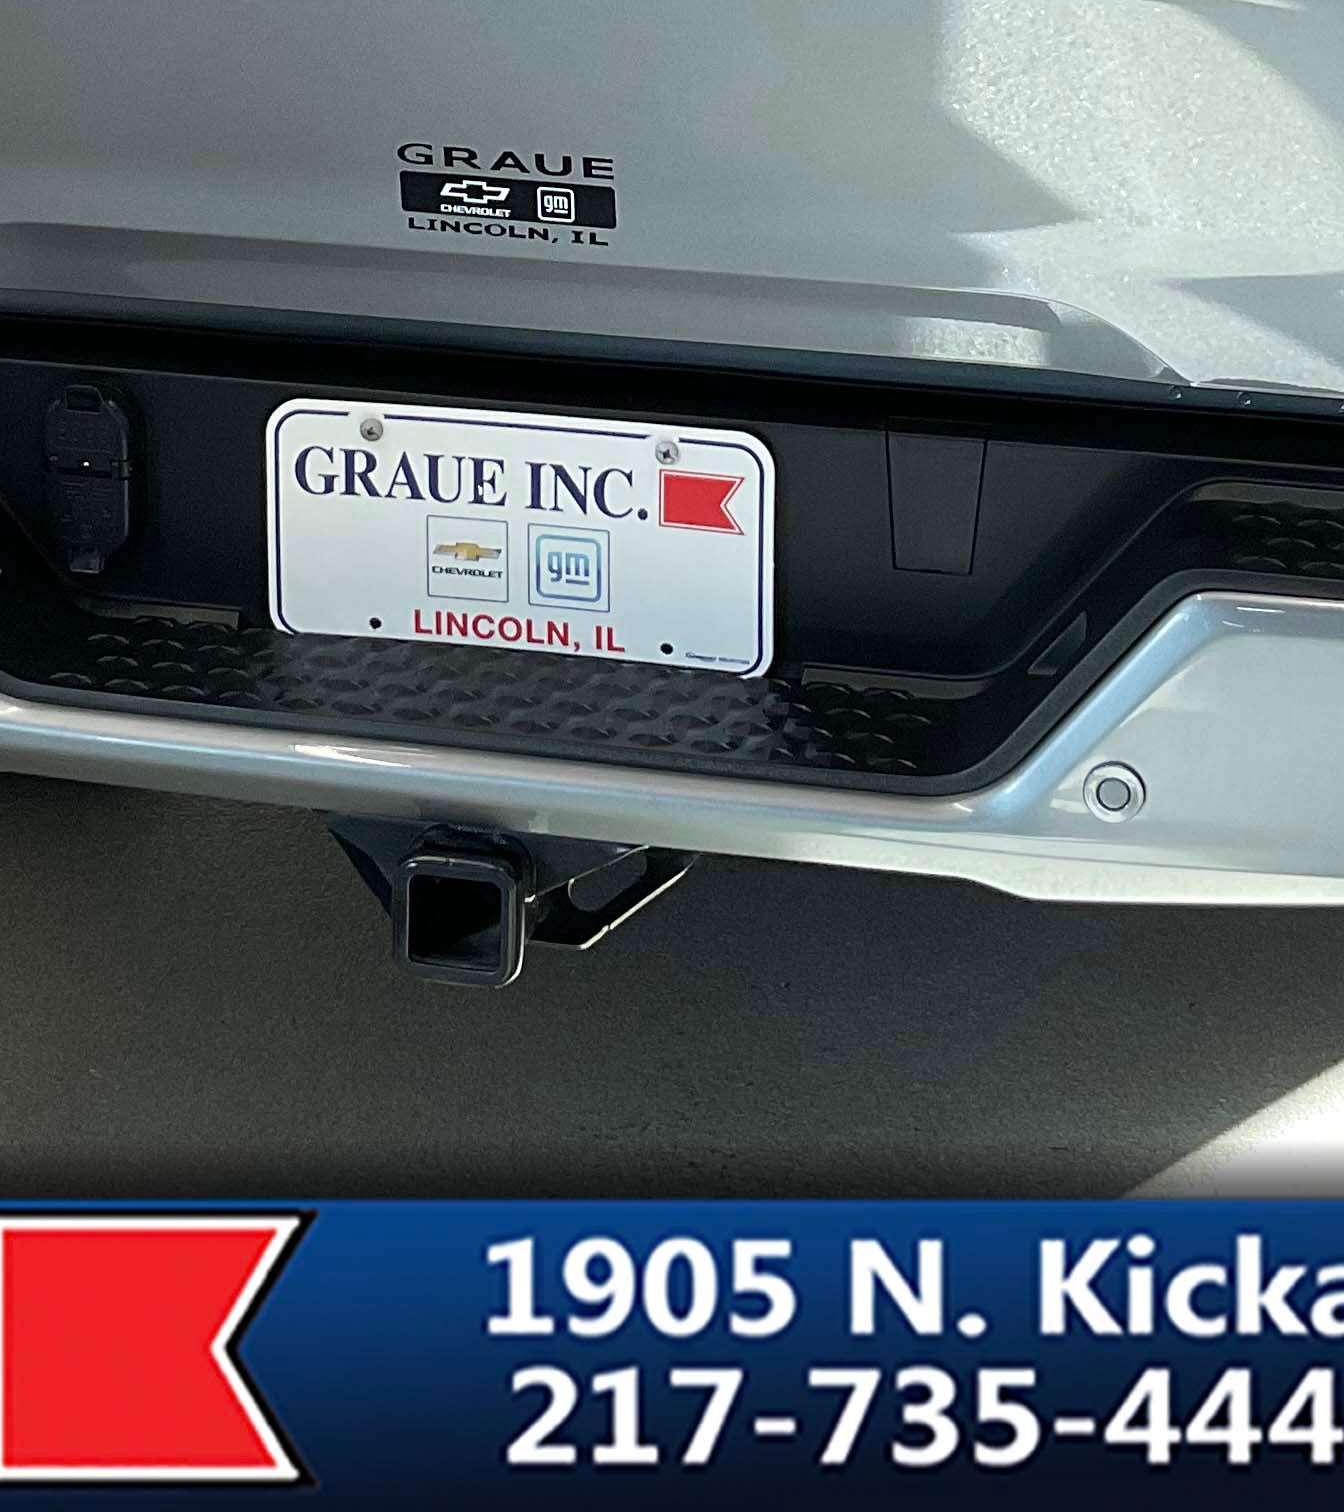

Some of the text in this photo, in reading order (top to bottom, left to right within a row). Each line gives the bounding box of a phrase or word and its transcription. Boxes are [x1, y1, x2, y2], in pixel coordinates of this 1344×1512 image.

[397, 143, 615, 180] GRAUE
[440, 203, 511, 218] CHEVROLET
[543, 192, 569, 214] gm
[408, 216, 609, 246] LINCOLN, IL
[294, 445, 649, 520] GRAUE INC.
[431, 564, 504, 579] CHEVROLET
[547, 550, 590, 587] gm
[413, 609, 626, 652] LINCOLN, IL
